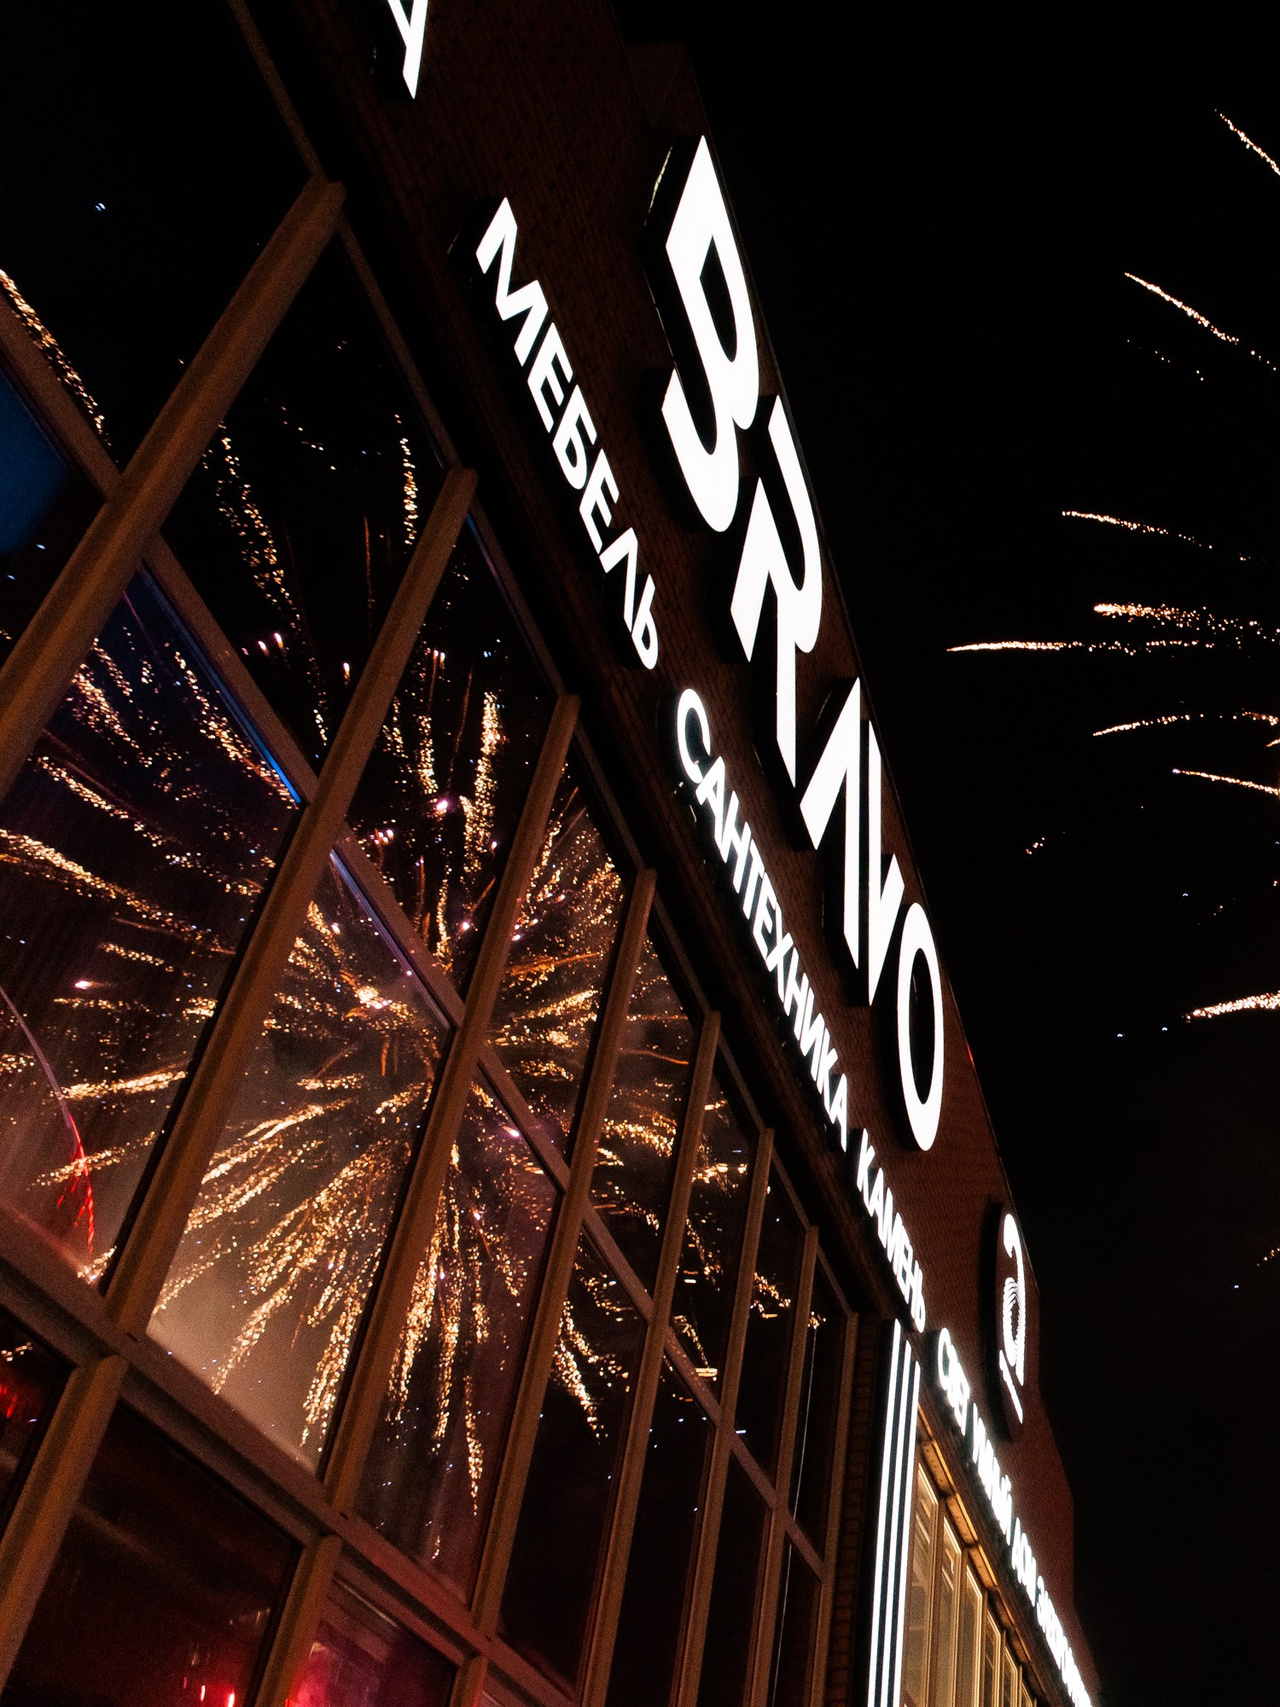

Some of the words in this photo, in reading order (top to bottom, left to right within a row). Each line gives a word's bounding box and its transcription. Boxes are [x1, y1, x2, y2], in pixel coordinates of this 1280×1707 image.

[475, 196, 659, 670] МЕБЕЛЬ
[677, 688, 848, 1153] САНТЕХНИКА
[856, 1127, 926, 1334] КАМЕНЬ
[937, 1326, 972, 1437] СВЕТ
[662, 135, 945, 1151] BRAVO
